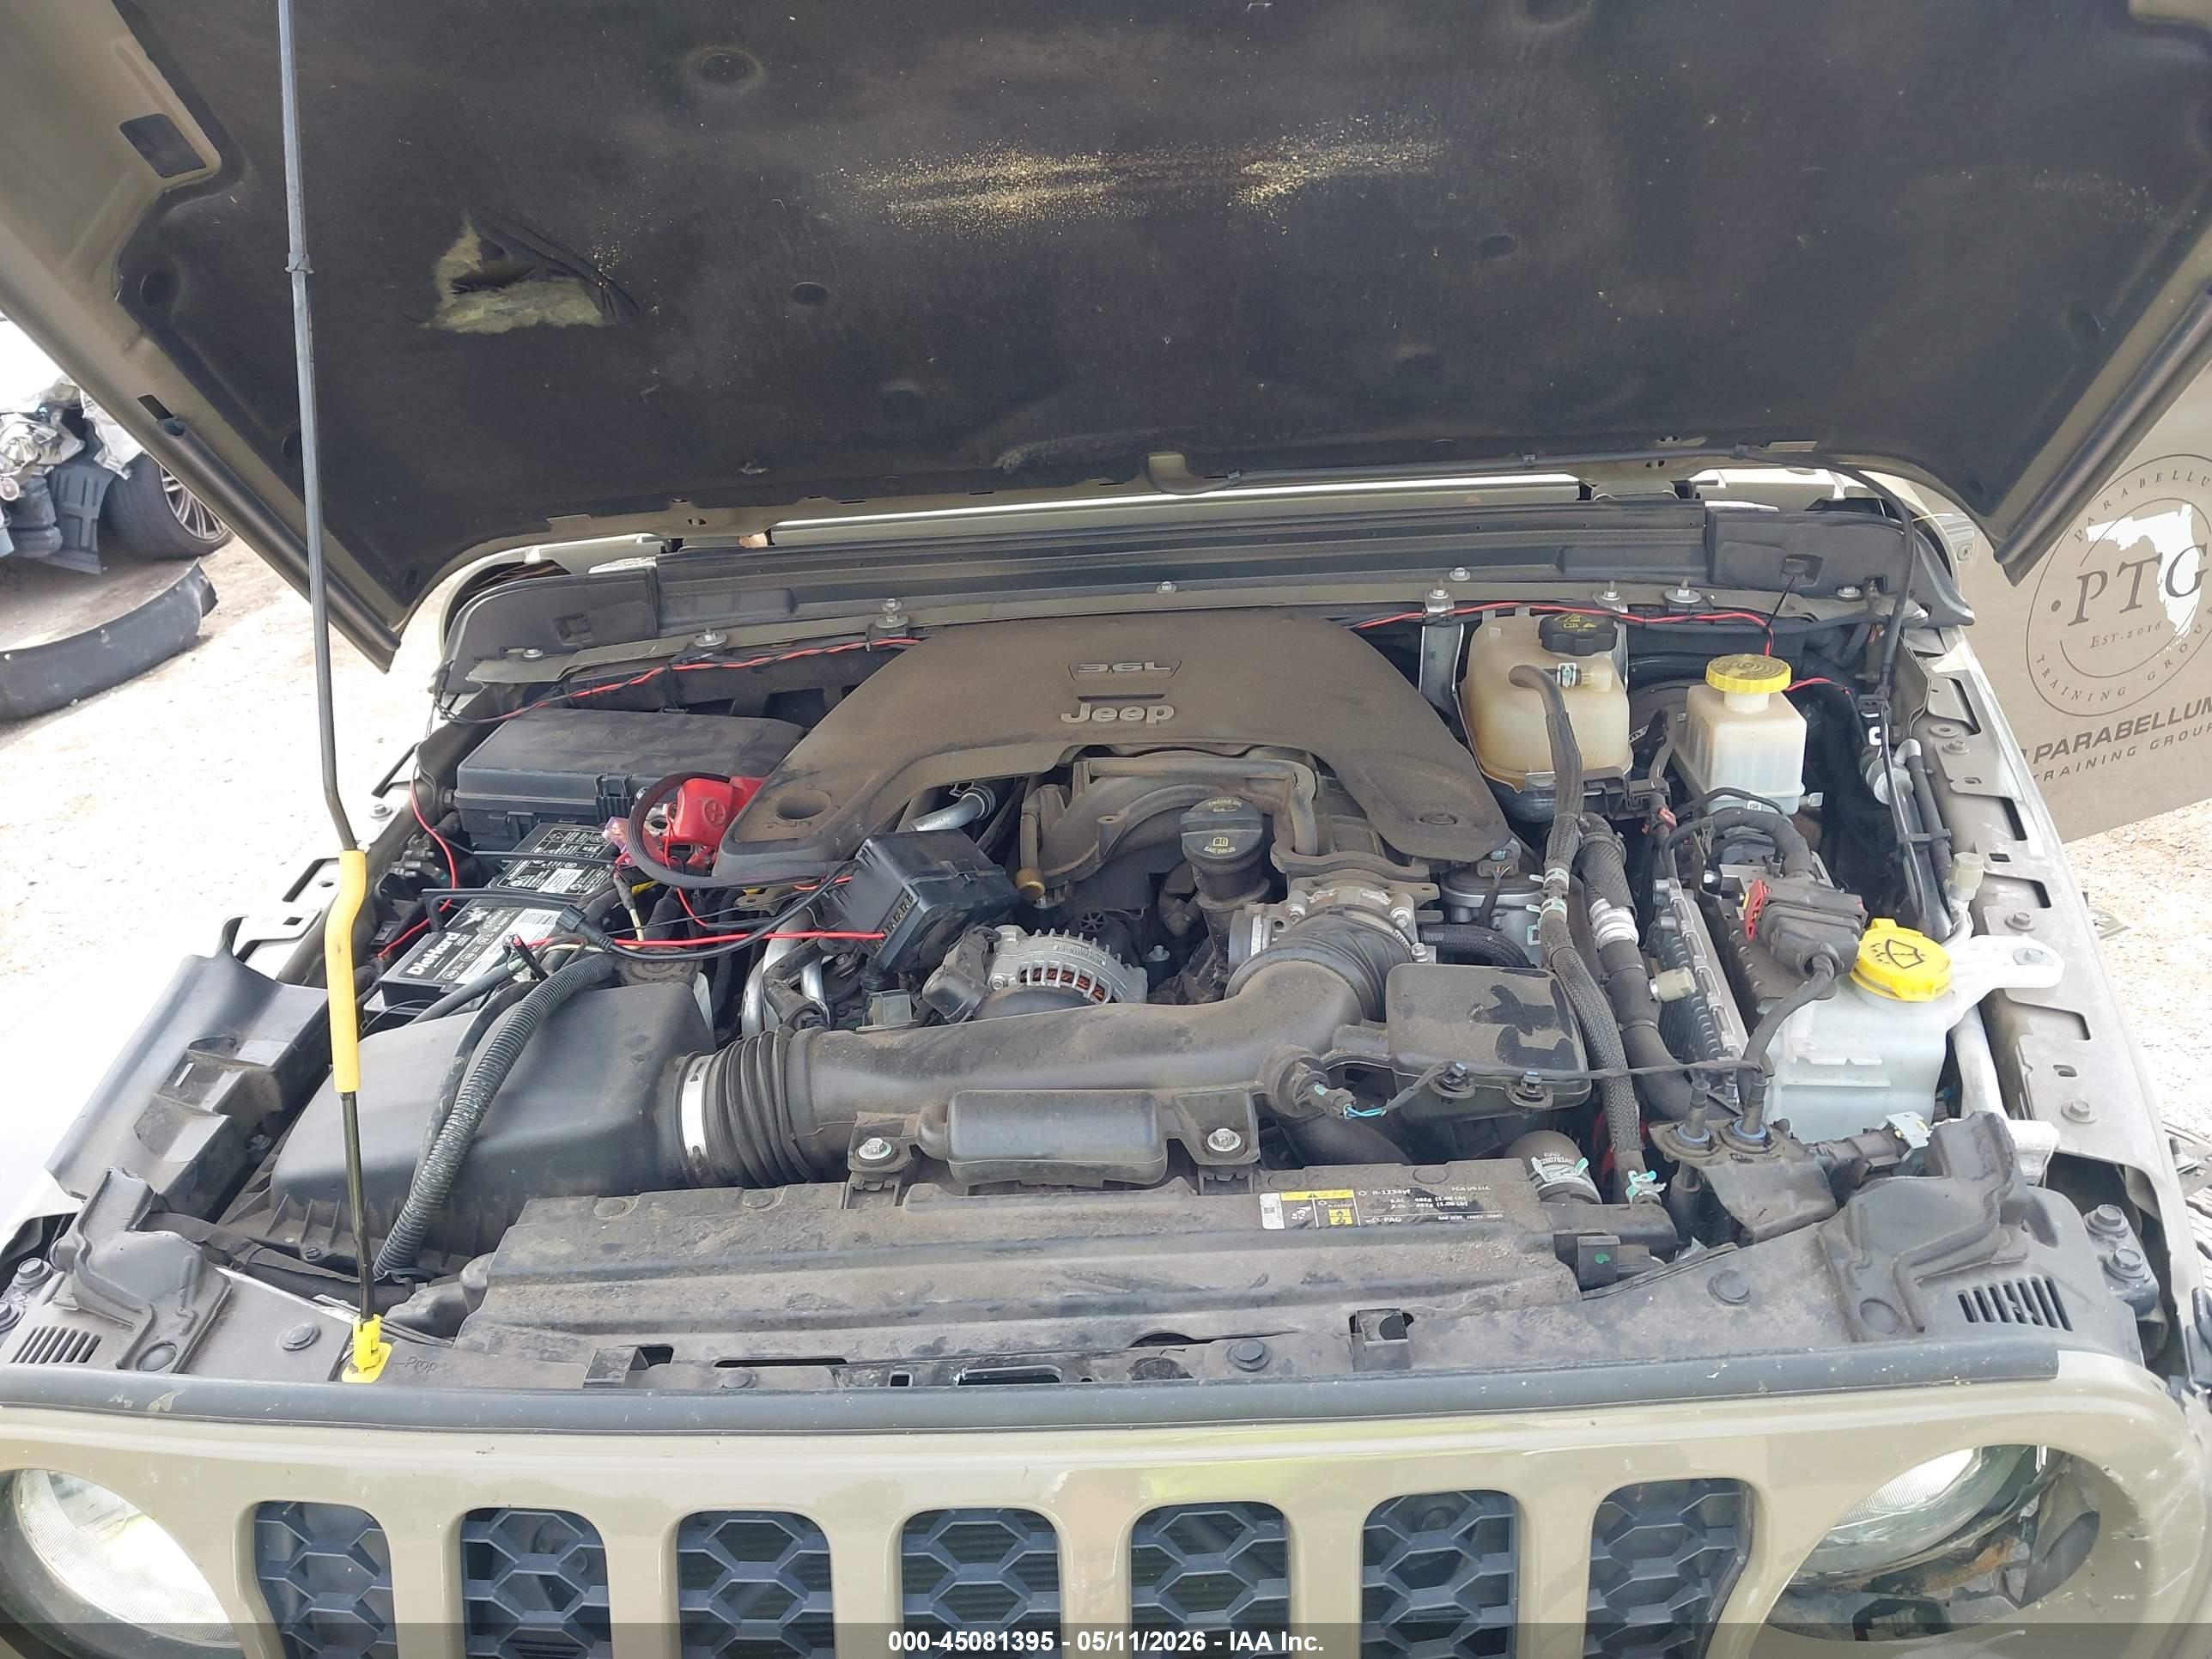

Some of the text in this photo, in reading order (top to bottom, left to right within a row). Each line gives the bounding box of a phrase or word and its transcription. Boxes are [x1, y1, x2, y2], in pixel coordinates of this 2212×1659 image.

[2068, 542, 2209, 626] PTG
[2036, 653, 2127, 702] TRAINING
[1060, 702, 1175, 724] Jeep
[405, 931, 462, 976] DieHard
[405, 1356, 439, 1374] Prop
